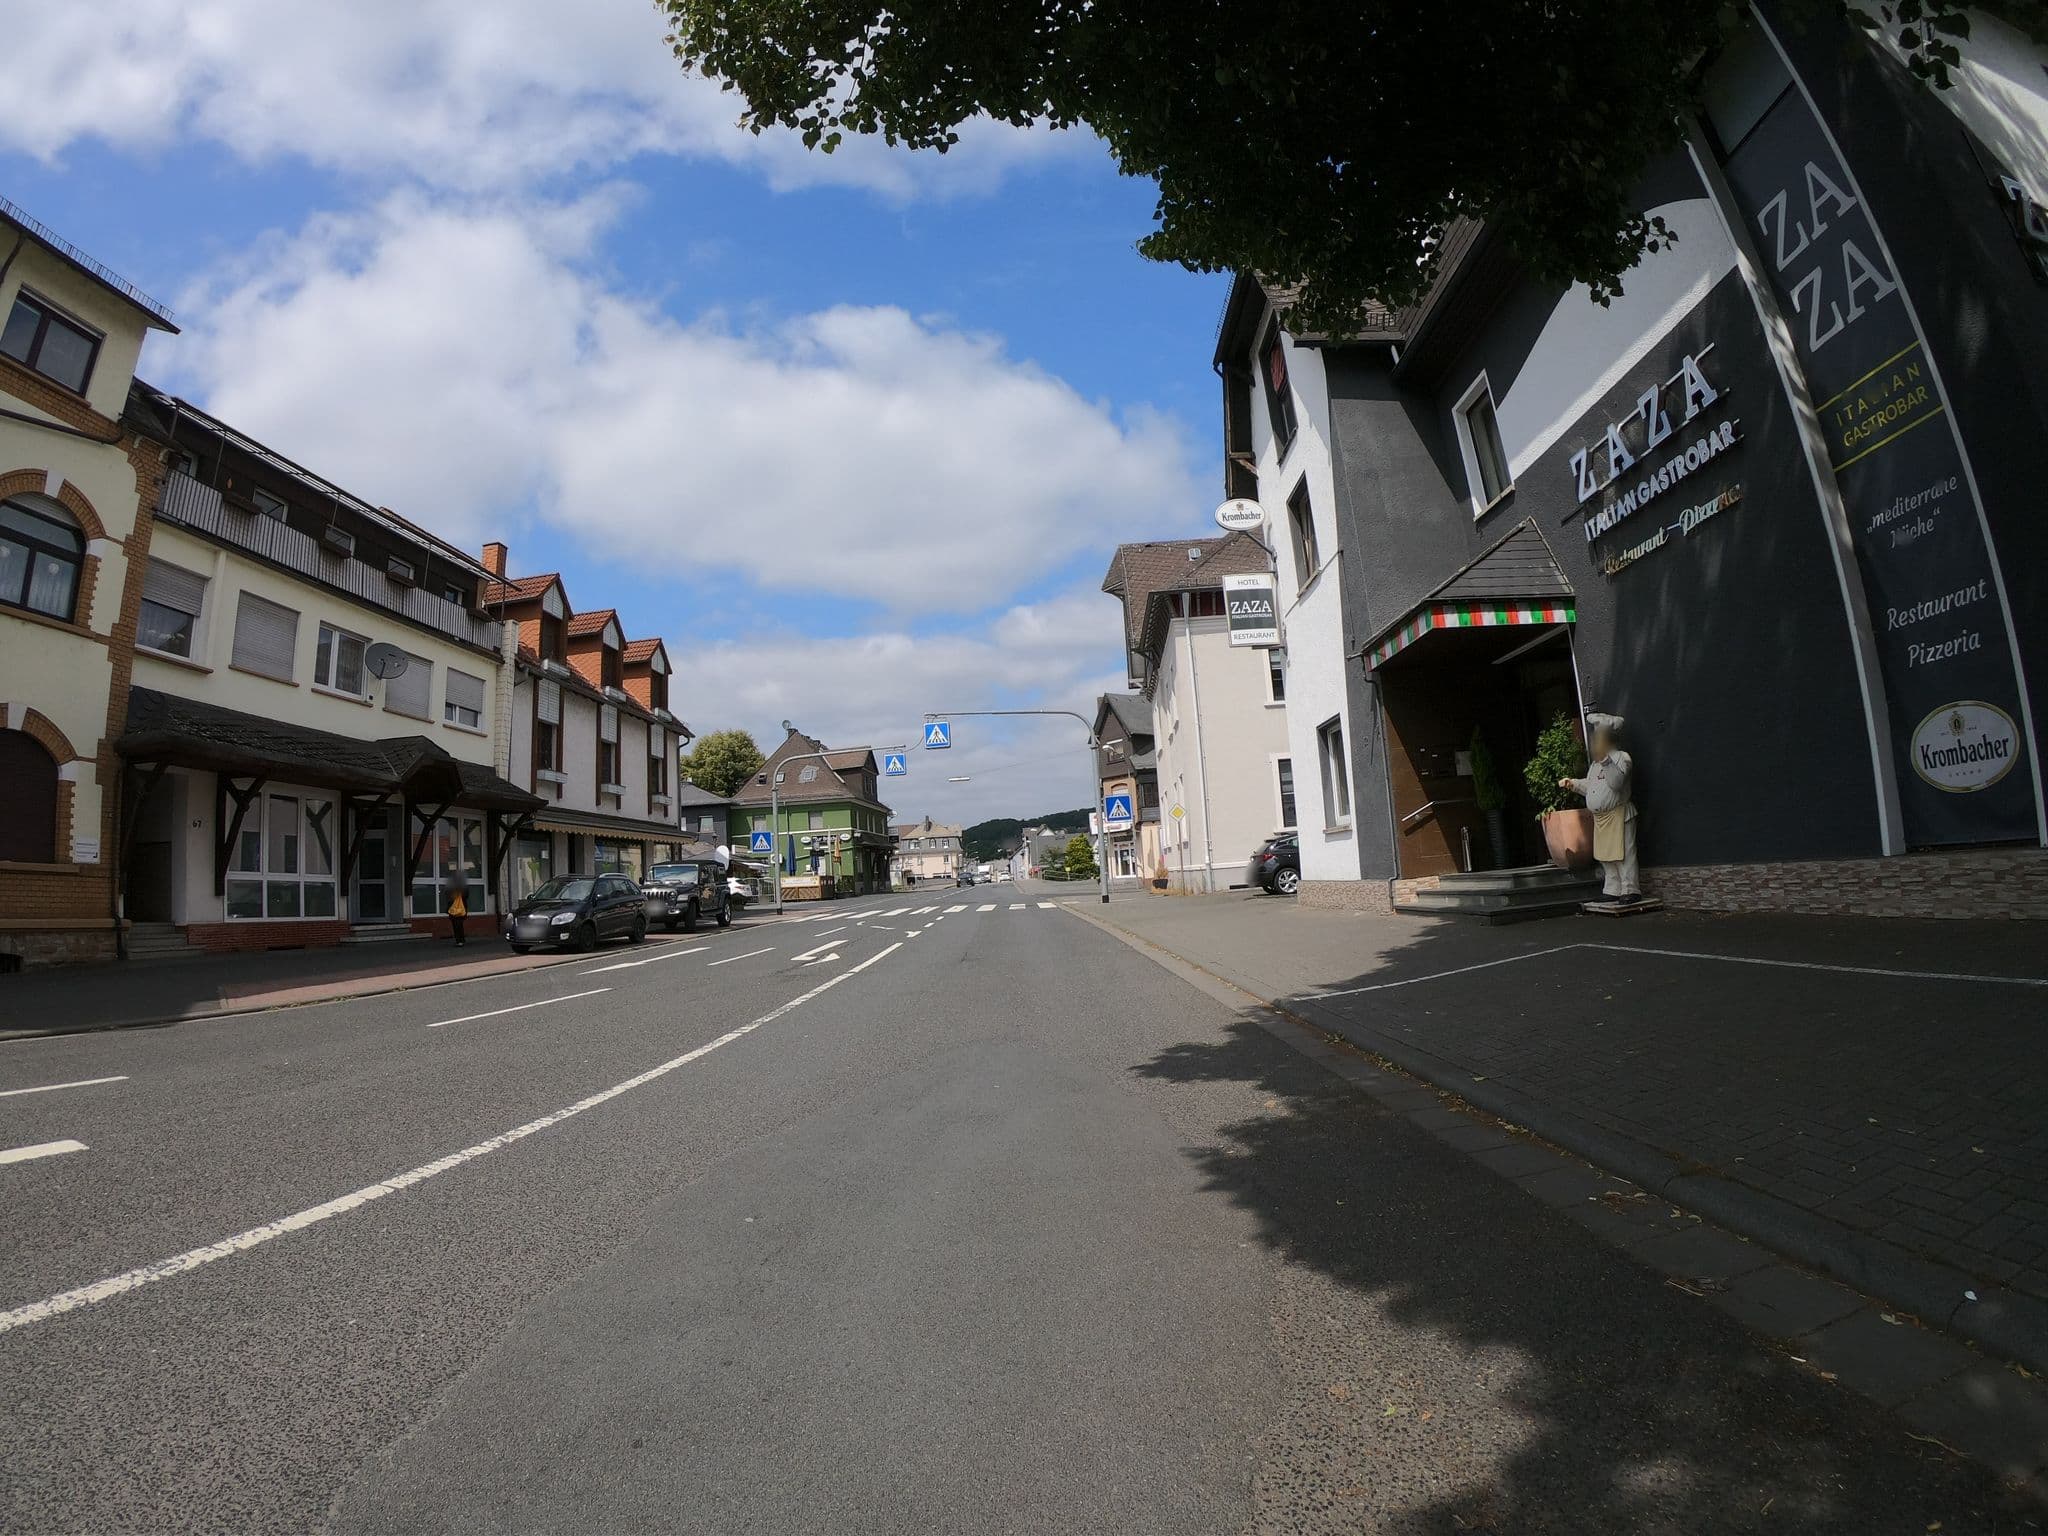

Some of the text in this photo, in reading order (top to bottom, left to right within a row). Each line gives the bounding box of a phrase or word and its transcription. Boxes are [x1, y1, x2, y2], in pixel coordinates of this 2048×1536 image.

[1757, 161, 1857, 272] ZA
[1790, 239, 1897, 352] ZA
[1568, 354, 1718, 504] ZAZA
[1843, 385, 1928, 447] GASTROBAR
[1583, 421, 1736, 542] ITALIAN GASTROBAR
[1221, 511, 1261, 523] Krombacher
[1230, 600, 1272, 614] ZAZA
[1887, 578, 1988, 631] Restaurant
[1233, 632, 1275, 640] RESTAURANT
[1908, 629, 1981, 668] Pizzeria
[1920, 734, 2009, 770] Krombacher
[192, 819, 202, 829] 67
